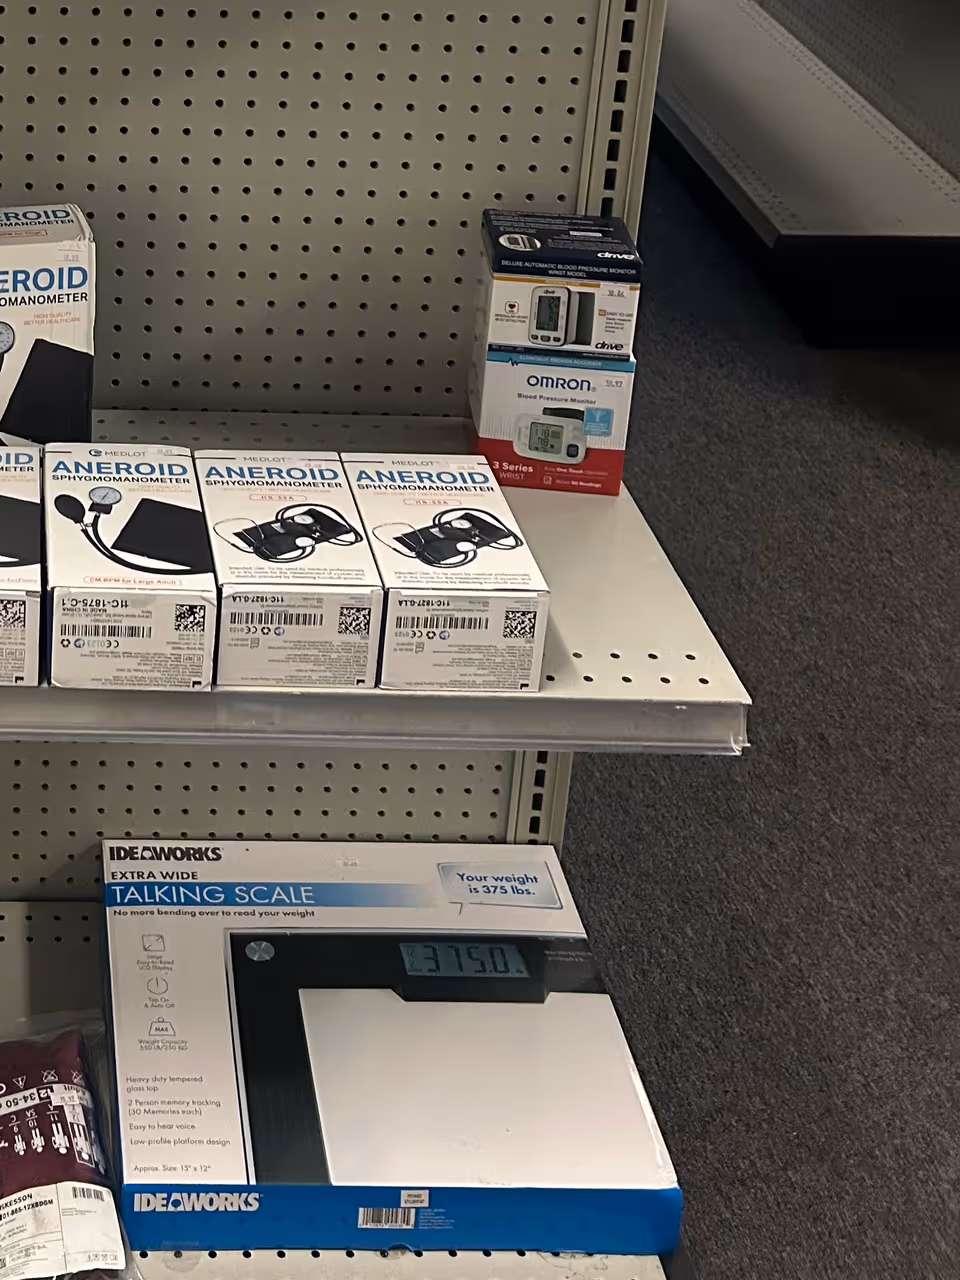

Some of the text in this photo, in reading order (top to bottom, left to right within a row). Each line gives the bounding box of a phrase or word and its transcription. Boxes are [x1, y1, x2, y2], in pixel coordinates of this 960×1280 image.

[597, 251, 635, 260] drive
[595, 341, 624, 351] drive
[527, 375, 591, 391] OMRON
[104, 449, 146, 457] MEDLOT
[51, 461, 188, 476] ANEROID
[493, 461, 533, 473] 3 Series
[205, 466, 340, 481] ANEROID
[356, 470, 490, 485] ANEROID
[499, 472, 525, 480] WRIST
[51, 474, 191, 484] SPHYGMOMANOMETER
[205, 480, 343, 488] SPHYGMOMANOMETER
[356, 483, 495, 493] SPHYGMOMANOMETER
[61, 598, 129, 608] 11C-1875-C.1
[108, 846, 222, 862] IDEAWORKS
[111, 871, 199, 881] EXTRA WIDE
[456, 872, 538, 884] Your weight
[111, 886, 315, 903] TALKING SCALE
[468, 885, 536, 895] is 375 lbs.
[113, 909, 128, 917] No
[157, 908, 196, 918] bending
[232, 909, 257, 917] read
[281, 909, 315, 918] weight
[6, 1092, 36, 1108] 34-50
[182, 1108, 202, 1116] each)
[134, 1193, 260, 1211] IDEAWORKS
